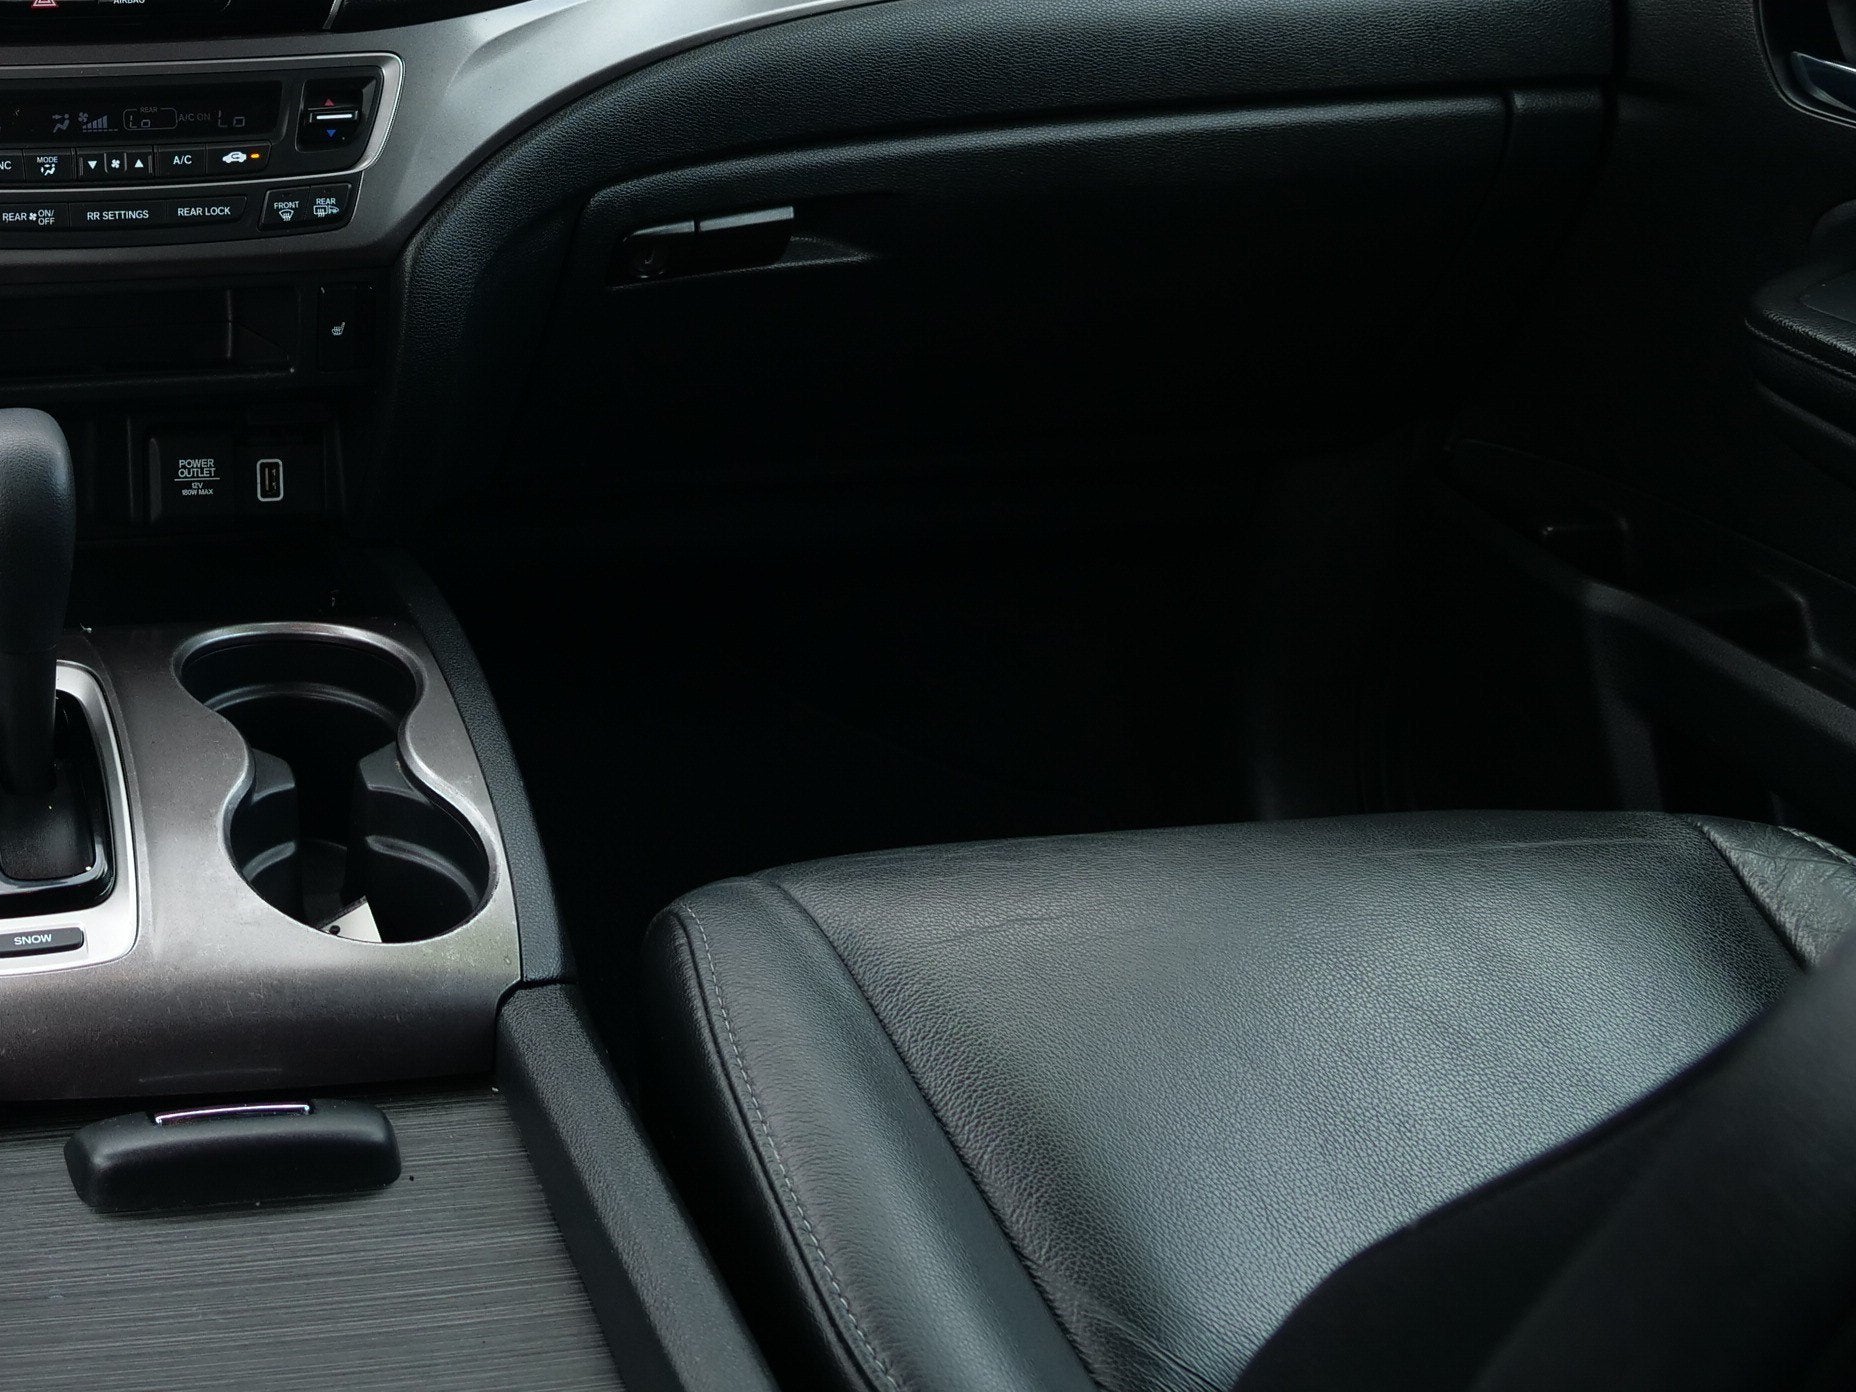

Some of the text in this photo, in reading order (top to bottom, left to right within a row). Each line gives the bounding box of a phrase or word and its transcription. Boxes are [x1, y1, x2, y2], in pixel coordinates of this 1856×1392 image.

[178, 112, 212, 122] A/C ON
[173, 155, 192, 165] A/C
[274, 201, 299, 209] FRONT
[316, 197, 336, 205] REAR
[37, 209, 55, 218] ON/
[87, 210, 149, 221] RR SETTINGS
[177, 206, 231, 216] REAR LOCK
[2, 212, 27, 222] REAR
[38, 217, 55, 226] OFF
[178, 459, 215, 468] POWER
[178, 467, 216, 477] OUTLET
[13, 933, 52, 946] SNOW
